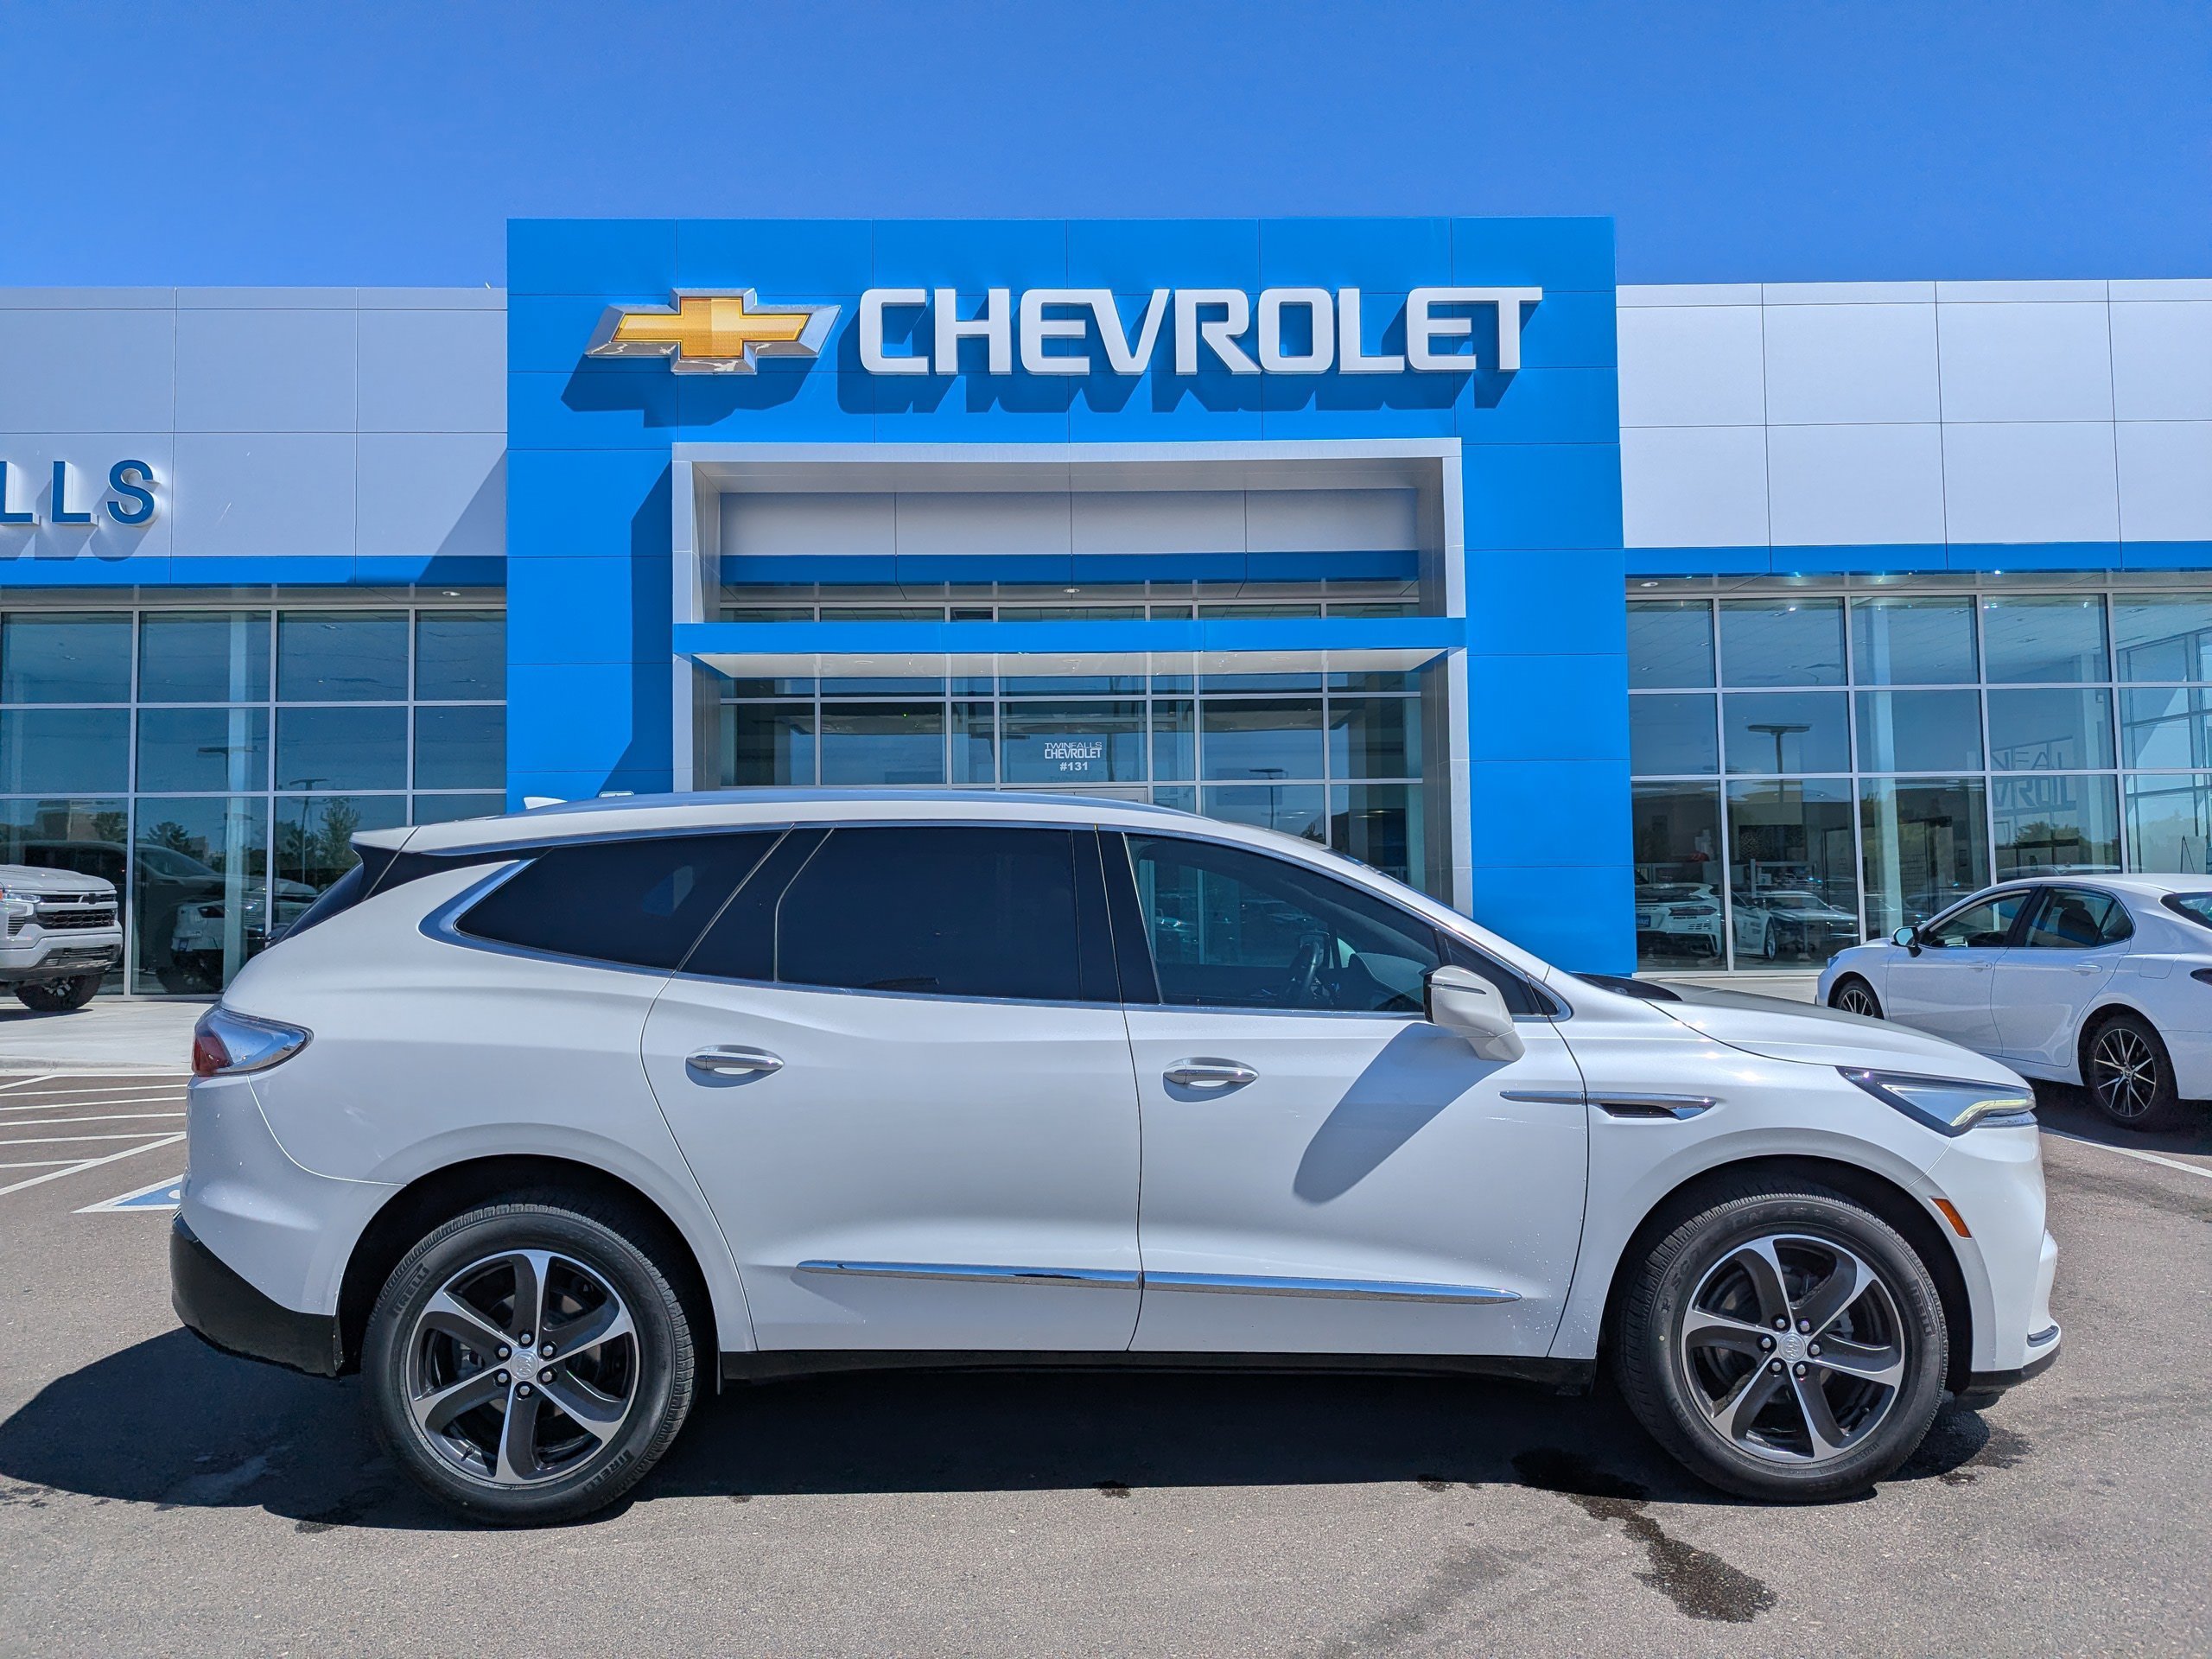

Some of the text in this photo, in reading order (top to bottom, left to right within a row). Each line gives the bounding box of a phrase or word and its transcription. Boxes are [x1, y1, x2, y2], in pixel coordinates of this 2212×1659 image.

[860, 287, 1543, 375] CHEVROLET
[0, 460, 156, 524] LLS
[1044, 748, 1103, 760] CHEVROLET
[1059, 762, 1088, 772] #131
